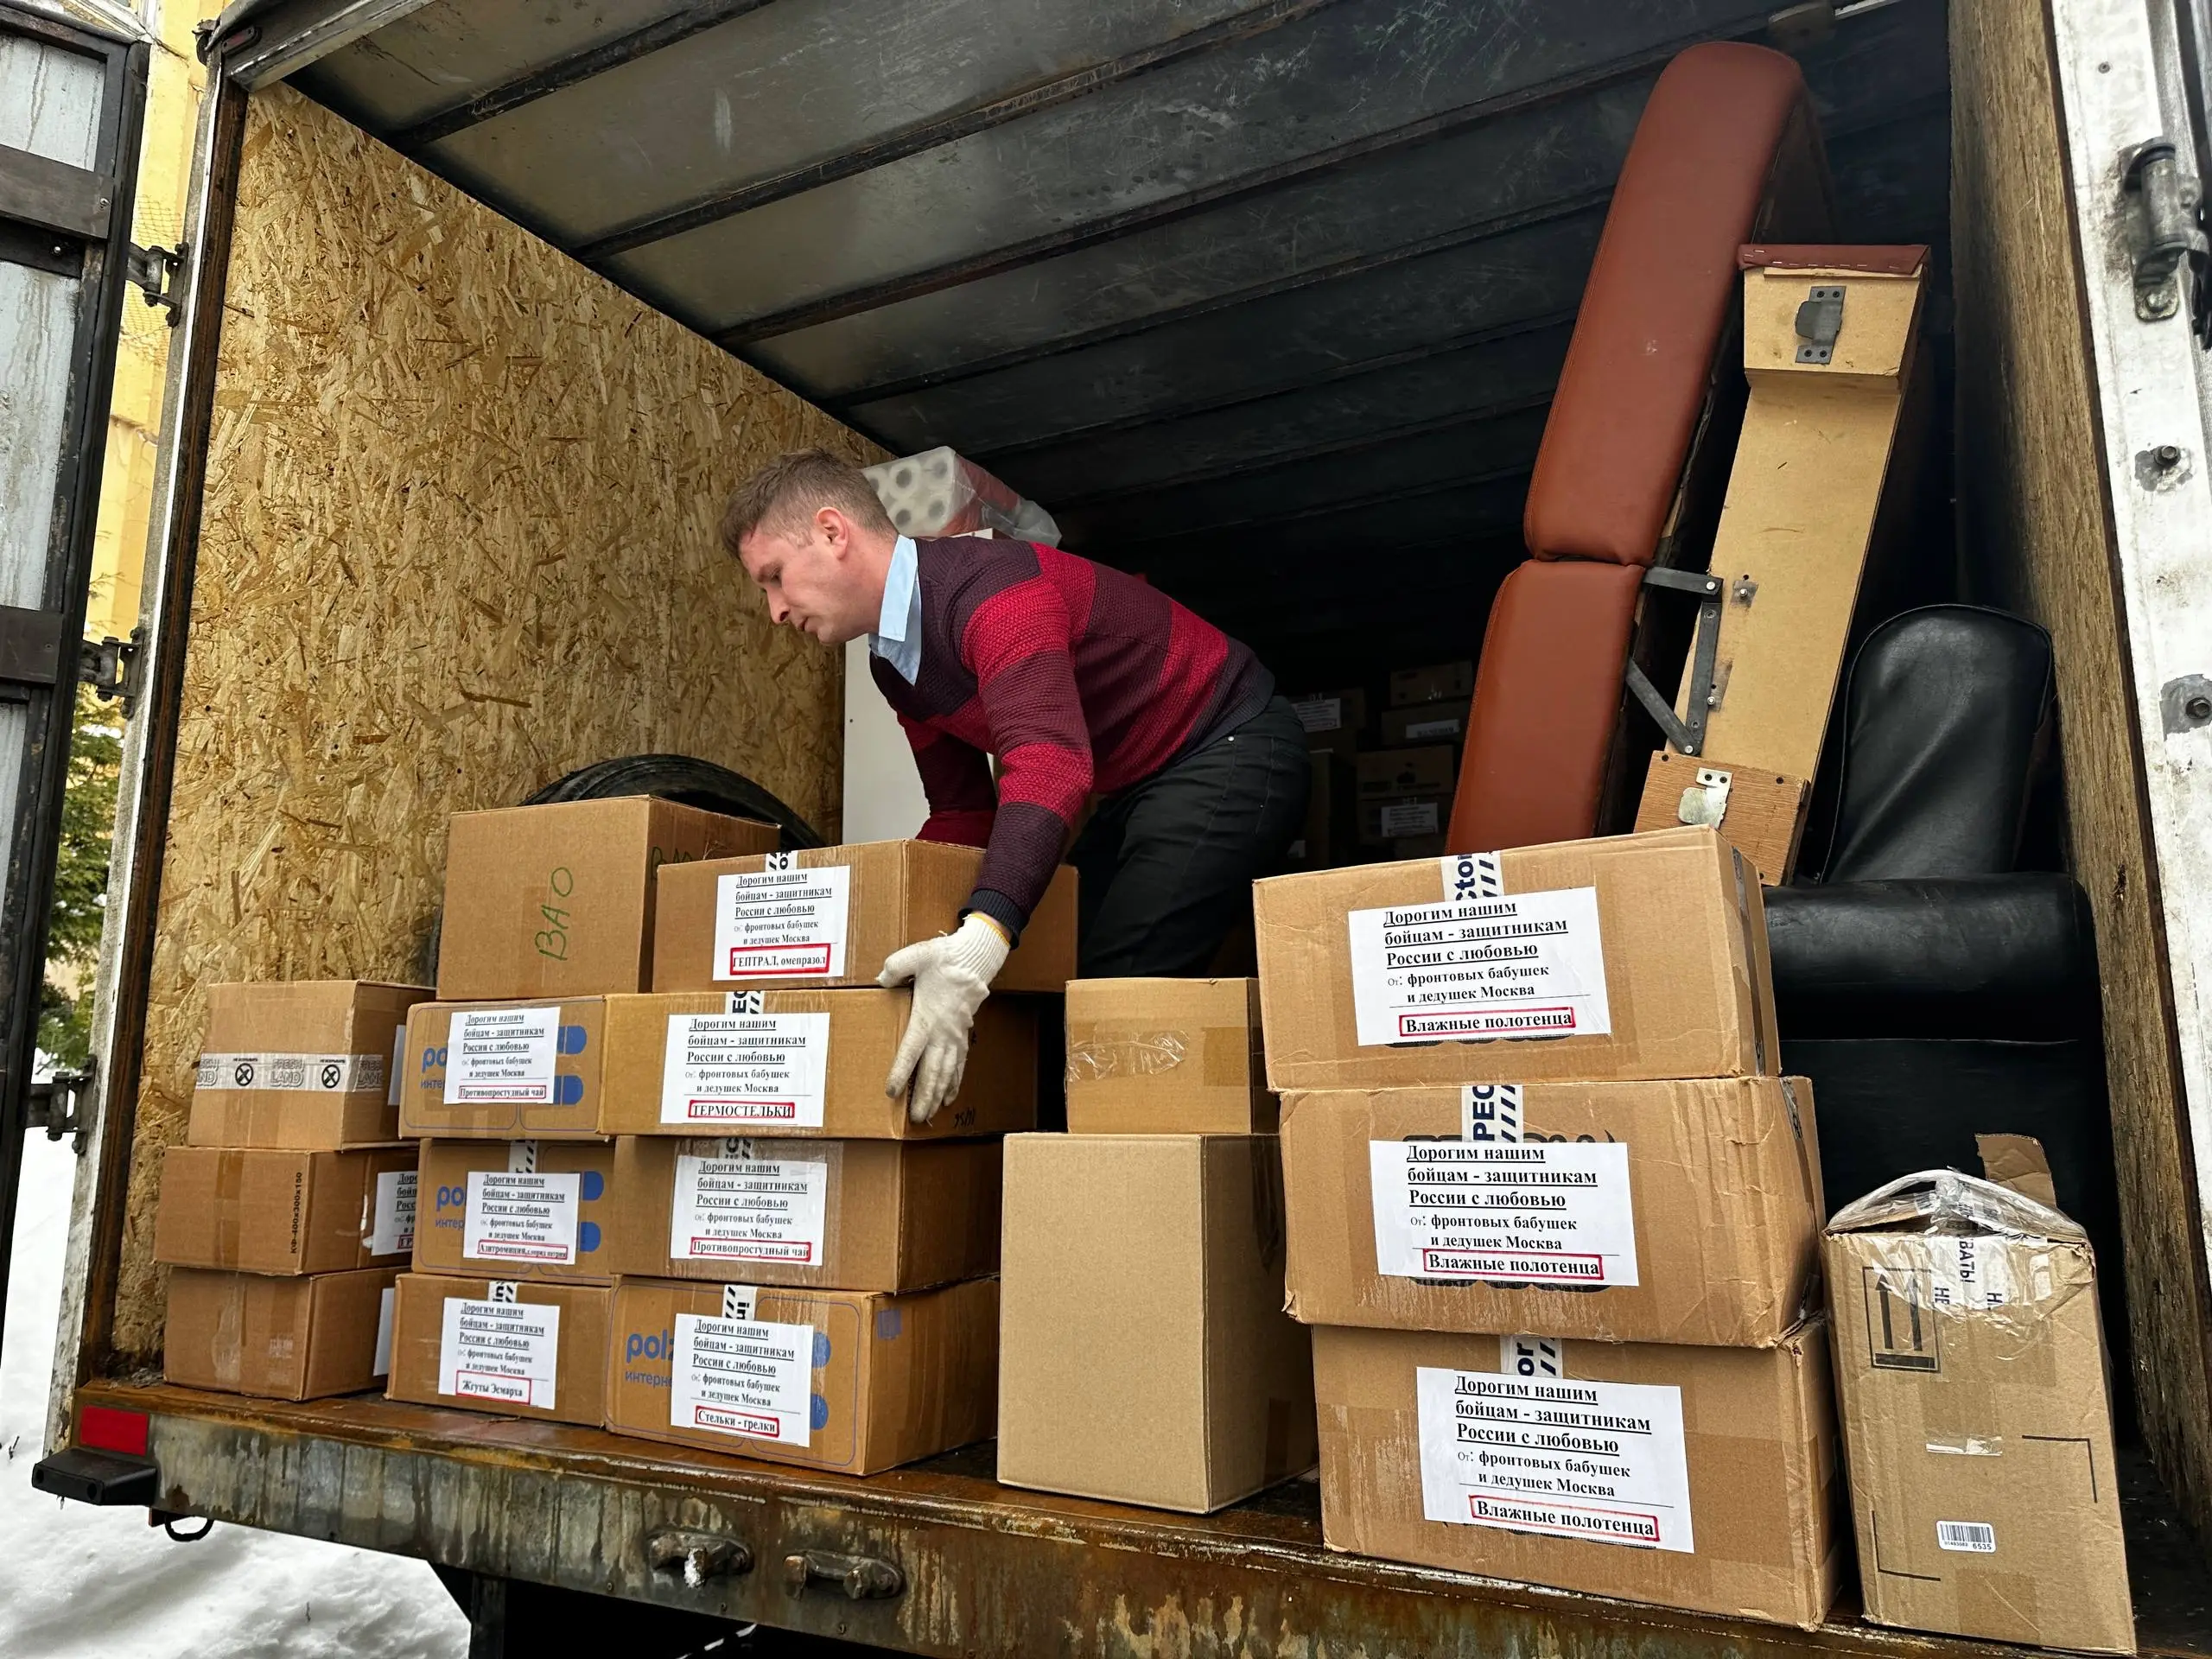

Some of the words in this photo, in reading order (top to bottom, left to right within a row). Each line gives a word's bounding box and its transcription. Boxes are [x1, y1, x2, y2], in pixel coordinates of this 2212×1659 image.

[735, 875, 773, 887] Дорогим
[776, 874, 807, 883] нашим
[735, 891, 766, 901] бойцам
[775, 888, 832, 899] защитникам
[735, 906, 765, 917] России
[773, 904, 815, 914] любовью
[1383, 909, 1452, 926] Дорогим
[1459, 903, 1516, 918] нашим
[745, 923, 785, 933] фронтовых
[787, 920, 818, 931] бабушек
[1384, 930, 1443, 945] бойцам
[1459, 920, 1567, 939] защитникам
[749, 937, 780, 946] дедушек
[781, 934, 810, 943] Москва
[781, 956, 825, 967] омепразол
[1386, 952, 1441, 965] России
[1446, 951, 1454, 961] с
[1459, 944, 1537, 960] любовью
[1408, 971, 1484, 988] фронтовых
[1488, 966, 1548, 981] бабушек
[1420, 990, 1477, 1003] дедушек
[1480, 986, 1535, 998] Москва
[689, 1019, 735, 1030] Дорогим
[1406, 1018, 1480, 1033] Влажные
[1485, 1014, 1572, 1029] полотенца
[688, 1035, 727, 1046] бойцам
[687, 1052, 723, 1062] России
[734, 1052, 785, 1062] любовью
[699, 1069, 748, 1080] фронтовых
[751, 1069, 790, 1080] бабушек
[531, 1088, 544, 1096] чай
[704, 1085, 742, 1095] дедушек
[744, 1084, 779, 1092] Москва
[693, 1105, 791, 1117] ТЕРМОСТЕЛЬКИ
[1407, 1145, 1478, 1160] Дорогим
[1484, 1149, 1544, 1160] нашим
[698, 1161, 741, 1173] Дорогим
[397, 1173, 417, 1184] Доро
[1408, 1167, 1468, 1182] бойцам
[1484, 1172, 1597, 1183] защитникам
[697, 1178, 734, 1189] бойцам
[743, 1182, 808, 1192] защитникам
[397, 1200, 416, 1210] Росс
[696, 1194, 730, 1205] России
[741, 1196, 788, 1208] любовью
[1409, 1190, 1465, 1205] России
[1471, 1194, 1479, 1205] с
[1484, 1192, 1566, 1206] любовью
[708, 1212, 753, 1224] фронтовых
[756, 1214, 792, 1226] бабушек
[1431, 1214, 1510, 1230] фронтовых
[1514, 1216, 1576, 1232] бабушек
[712, 1229, 747, 1238] дедушек
[750, 1228, 782, 1238] Москва
[694, 1241, 789, 1256] Противопростудный
[792, 1247, 810, 1256] чай
[1431, 1236, 1439, 1245] и
[1443, 1237, 1502, 1249] дедушек
[1506, 1236, 1562, 1249] Москва
[1429, 1254, 1505, 1270] Влажные
[1510, 1261, 1599, 1275] полотенца
[694, 1320, 733, 1334] Дорогим
[736, 1327, 768, 1338] нашим
[693, 1337, 726, 1351] бойцам
[734, 1344, 794, 1358] защитникам
[693, 1354, 723, 1368] России
[733, 1360, 776, 1374] любовью
[462, 1380, 489, 1393] Жгуты
[702, 1373, 745, 1388] фронтовых
[747, 1379, 780, 1392] бабушек
[1454, 1376, 1529, 1396] Дорогим
[1535, 1387, 1597, 1402] нашим
[707, 1391, 739, 1402] дедушек
[741, 1393, 771, 1406] Москва
[698, 1410, 735, 1427] Стельки
[744, 1420, 775, 1432] грелки
[1455, 1400, 1518, 1419] бойцам
[1535, 1410, 1650, 1431] защитникам
[1457, 1423, 1516, 1442] России
[1522, 1433, 1530, 1444] с
[1535, 1433, 1618, 1452] любовью
[1480, 1451, 1560, 1470] фронтовых
[1566, 1459, 1629, 1477] бабушек
[1479, 1474, 1487, 1484] и
[1491, 1475, 1553, 1490] дедушек
[1557, 1478, 1614, 1497] Москва
[1478, 1501, 1555, 1524] Влажные
[1561, 1514, 1654, 1536] полотенца
